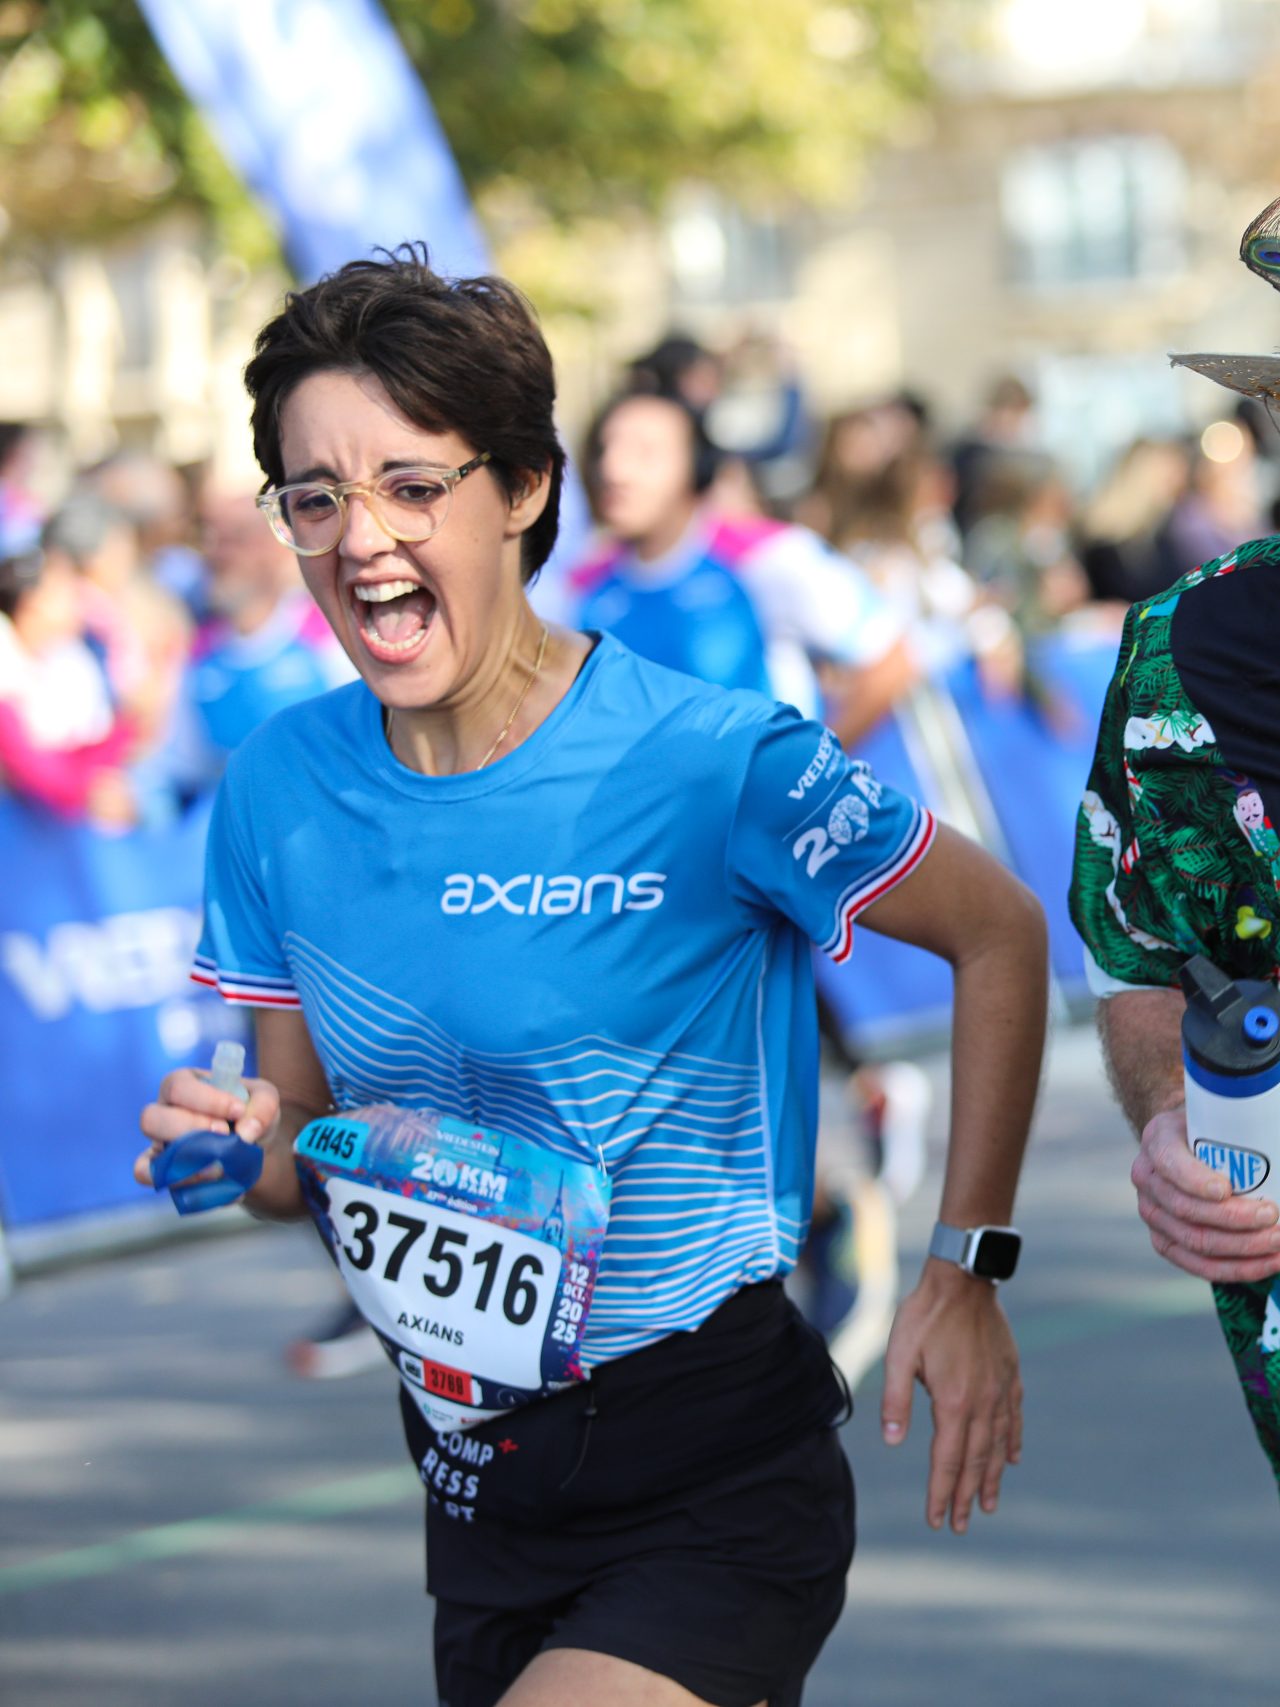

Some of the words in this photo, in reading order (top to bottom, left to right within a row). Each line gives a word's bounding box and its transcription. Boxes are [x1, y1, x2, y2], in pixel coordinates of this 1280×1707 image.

[440, 871, 668, 916] axians
[306, 1125, 360, 1160] 1H45
[342, 1201, 545, 1326] 37516
[569, 1261, 590, 1287] 12
[556, 1298, 583, 1323] 20
[397, 1311, 465, 1347] AXIANS
[551, 1319, 578, 1345] 25
[437, 1431, 495, 1468] COMP
[420, 1446, 480, 1500] RESS
